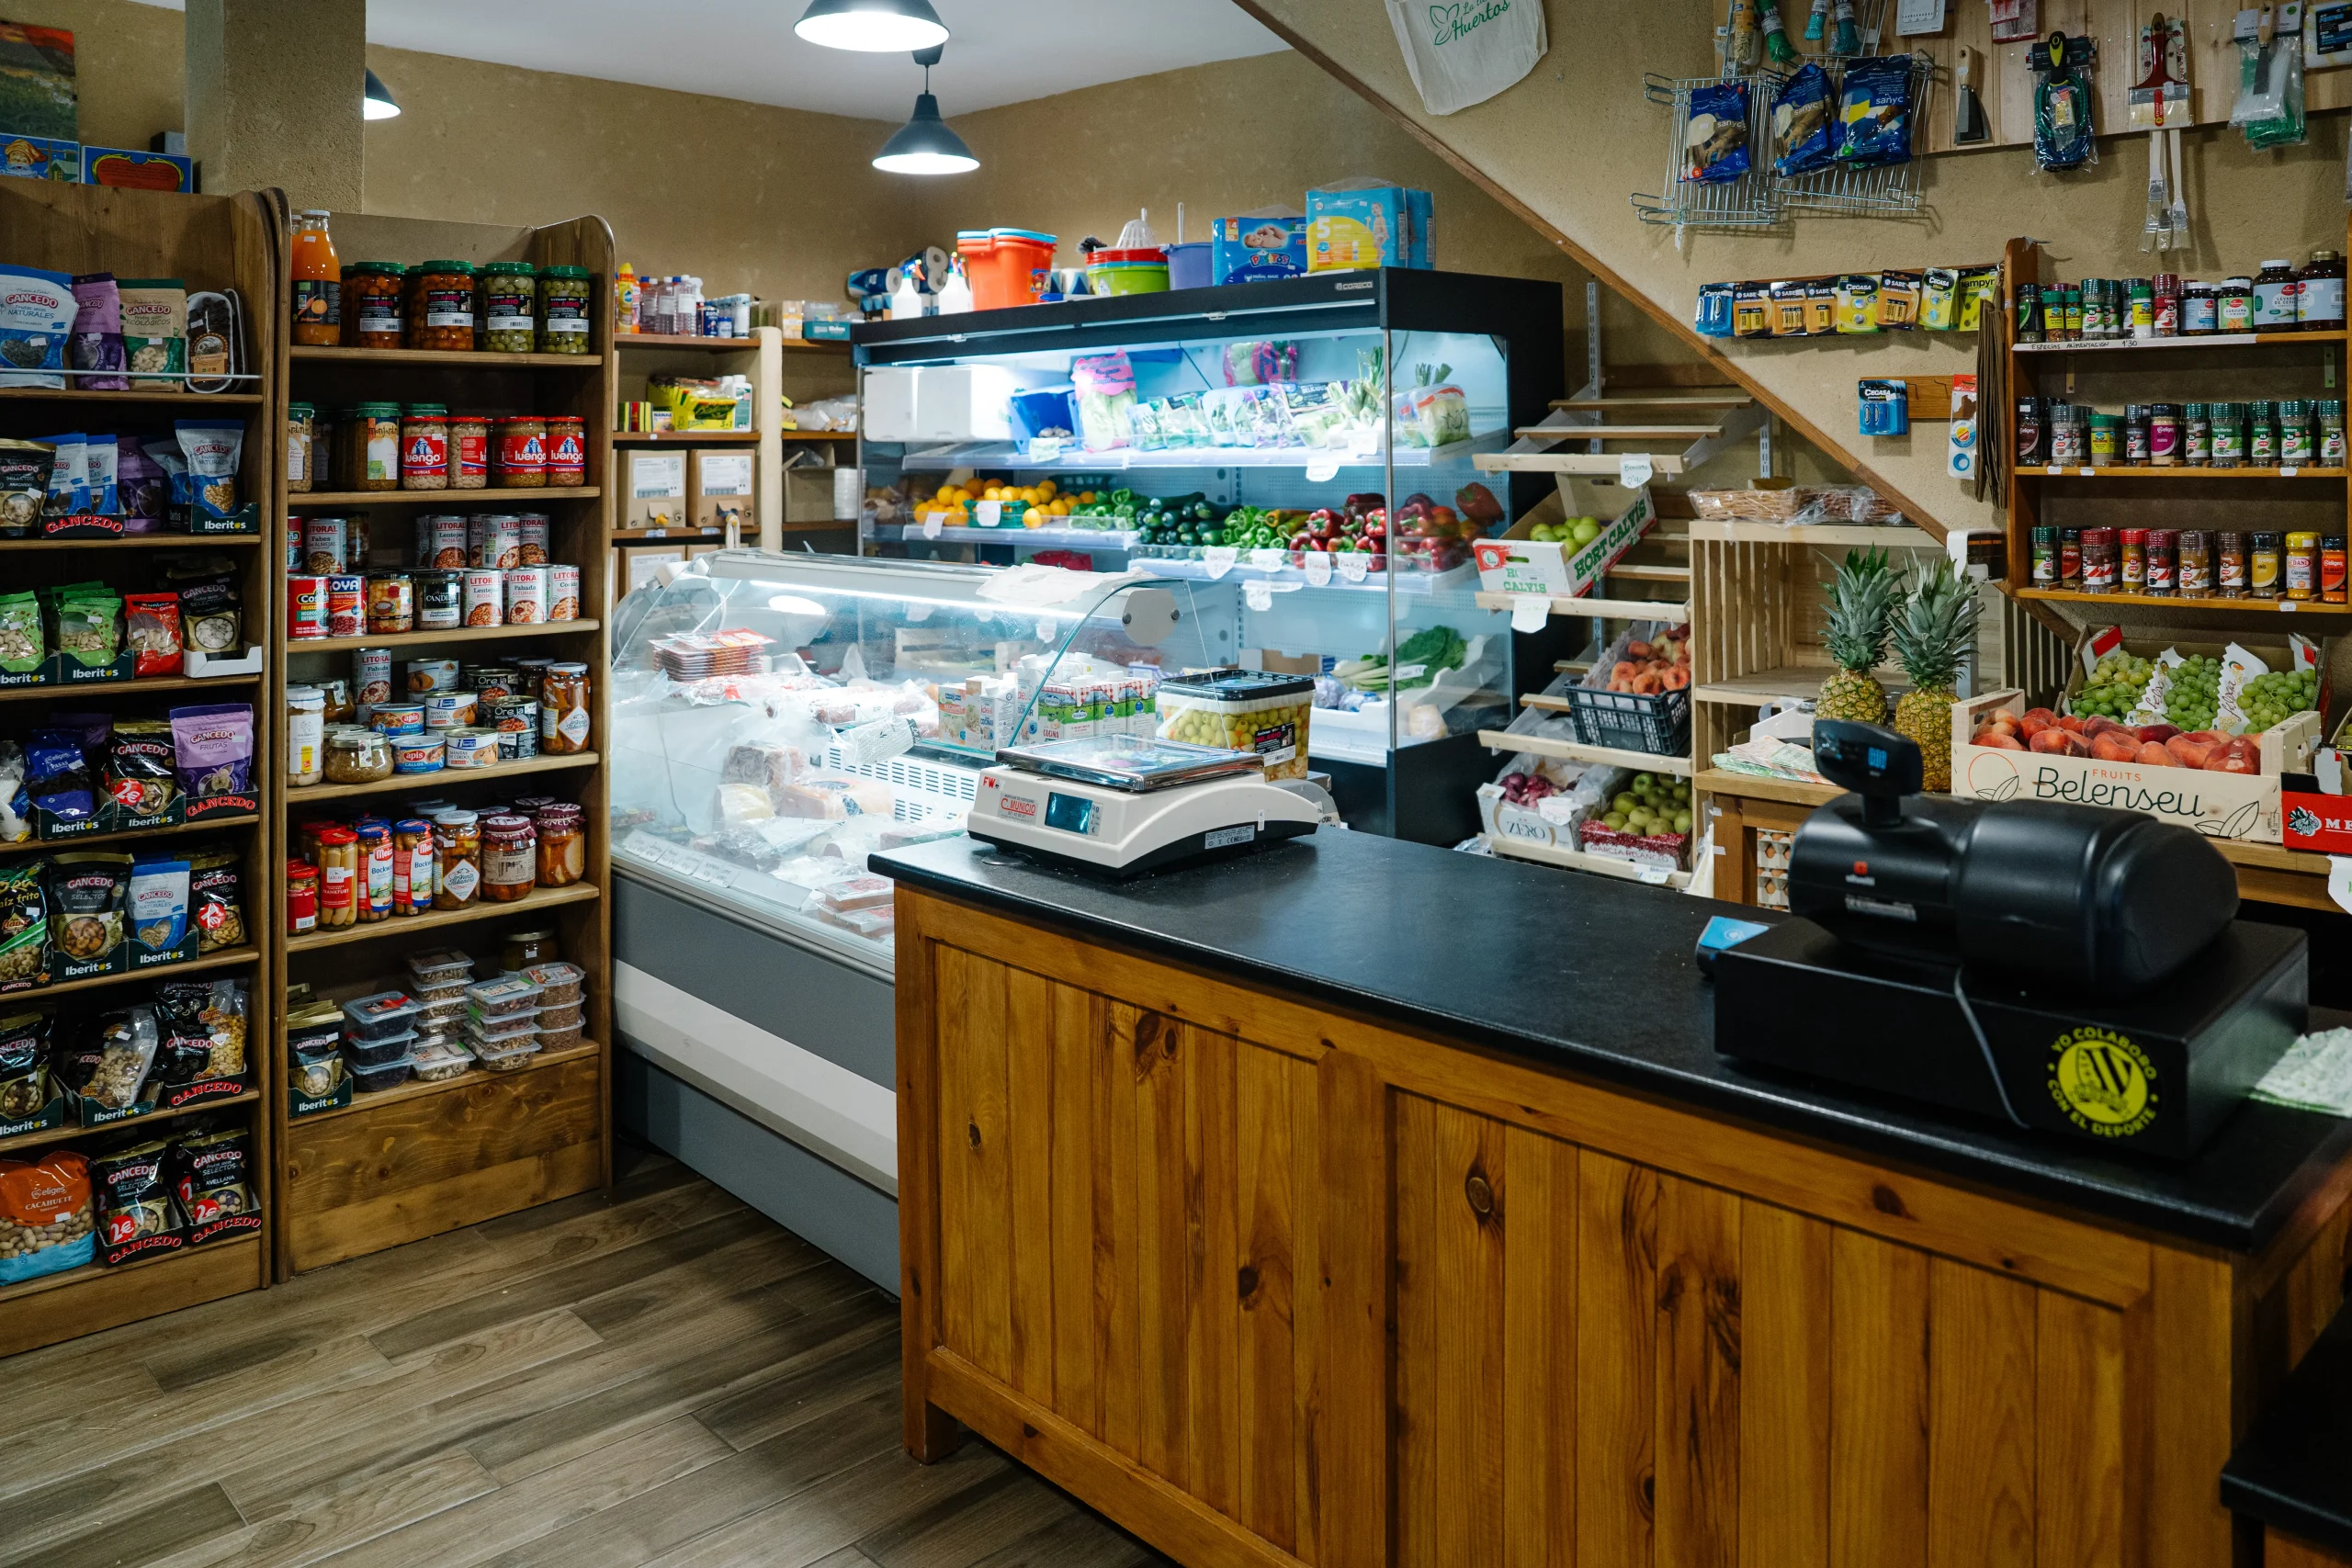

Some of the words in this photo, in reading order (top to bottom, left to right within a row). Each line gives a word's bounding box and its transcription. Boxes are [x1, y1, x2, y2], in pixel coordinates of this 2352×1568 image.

[1463, 3, 1475, 17] La
[1452, 0, 1510, 41] Huertos
[1875, 96, 1904, 105] sanyc
[1793, 101, 1818, 116] sanyc
[1717, 119, 1742, 129] sanyc
[1317, 218, 1330, 239] 5
[1342, 282, 1373, 290] CORECO
[1929, 277, 1949, 287] CEGASA
[6, 294, 59, 309] GANCEDO
[7, 310, 55, 319] NATURALES
[126, 305, 171, 314] GANCEDO
[193, 445, 232, 455] GANCEDO
[405, 453, 440, 465] luengo
[514, 450, 546, 463] luengo
[551, 450, 583, 463] luengo
[46, 515, 123, 533] GANCEDO
[205, 520, 246, 530] Iberitos
[1574, 540, 1607, 581] HORT
[469, 577, 500, 585] LITORAL
[510, 574, 541, 582] LITORAL
[184, 585, 226, 599] GANCEDO
[1503, 581, 1547, 593] CALVIS
[362, 654, 390, 663] LITORAL
[74, 669, 119, 679] Iberitos
[479, 677, 506, 687] Oreja
[403, 714, 418, 722] apis
[494, 707, 523, 717] Oreja
[190, 731, 234, 743] GANCEDO
[1256, 731, 1282, 743] HILARIO
[118, 744, 168, 755] GANCEDO
[199, 742, 228, 750] FRUTAS
[406, 751, 424, 760] apis
[2091, 768, 2142, 782] FRUITS
[983, 776, 996, 788] FW
[116, 783, 141, 803] 2€
[2035, 766, 2206, 818] Belenseu
[186, 796, 255, 817] GANCEDO
[52, 821, 98, 832] Iberitos
[129, 816, 173, 827] Iberitos
[67, 878, 114, 888] GANCEDO
[192, 875, 236, 890] GANCEDO
[17, 891, 40, 903] frito
[138, 891, 173, 901] GANCEDO
[141, 950, 184, 963] Iberitos
[65, 963, 111, 976] Iberitos
[2, 982, 31, 990] GANCEDO
[165, 1038, 213, 1049] GANCEDO
[297, 1037, 328, 1048] GANCEDO
[2051, 1034, 2072, 1055] YO
[2073, 1026, 2158, 1081] COLABORO
[171, 1082, 241, 1105] GANCEDO
[299, 1097, 338, 1111] Iberitos
[2047, 1078, 2071, 1113] CON
[2069, 1111, 2087, 1130] EL
[2091, 1108, 2156, 1138] DEPORTE
[193, 1152, 243, 1168] GANCEDO
[108, 1166, 156, 1185] GANCEDO
[203, 1164, 237, 1176] SELECTOS
[206, 1176, 234, 1185] AVELLANA
[26, 1196, 73, 1211] CACAHUETE
[110, 1219, 135, 1241] 2€
[192, 1217, 261, 1243] GANCEDO
[108, 1237, 182, 1263] GANCEDO
